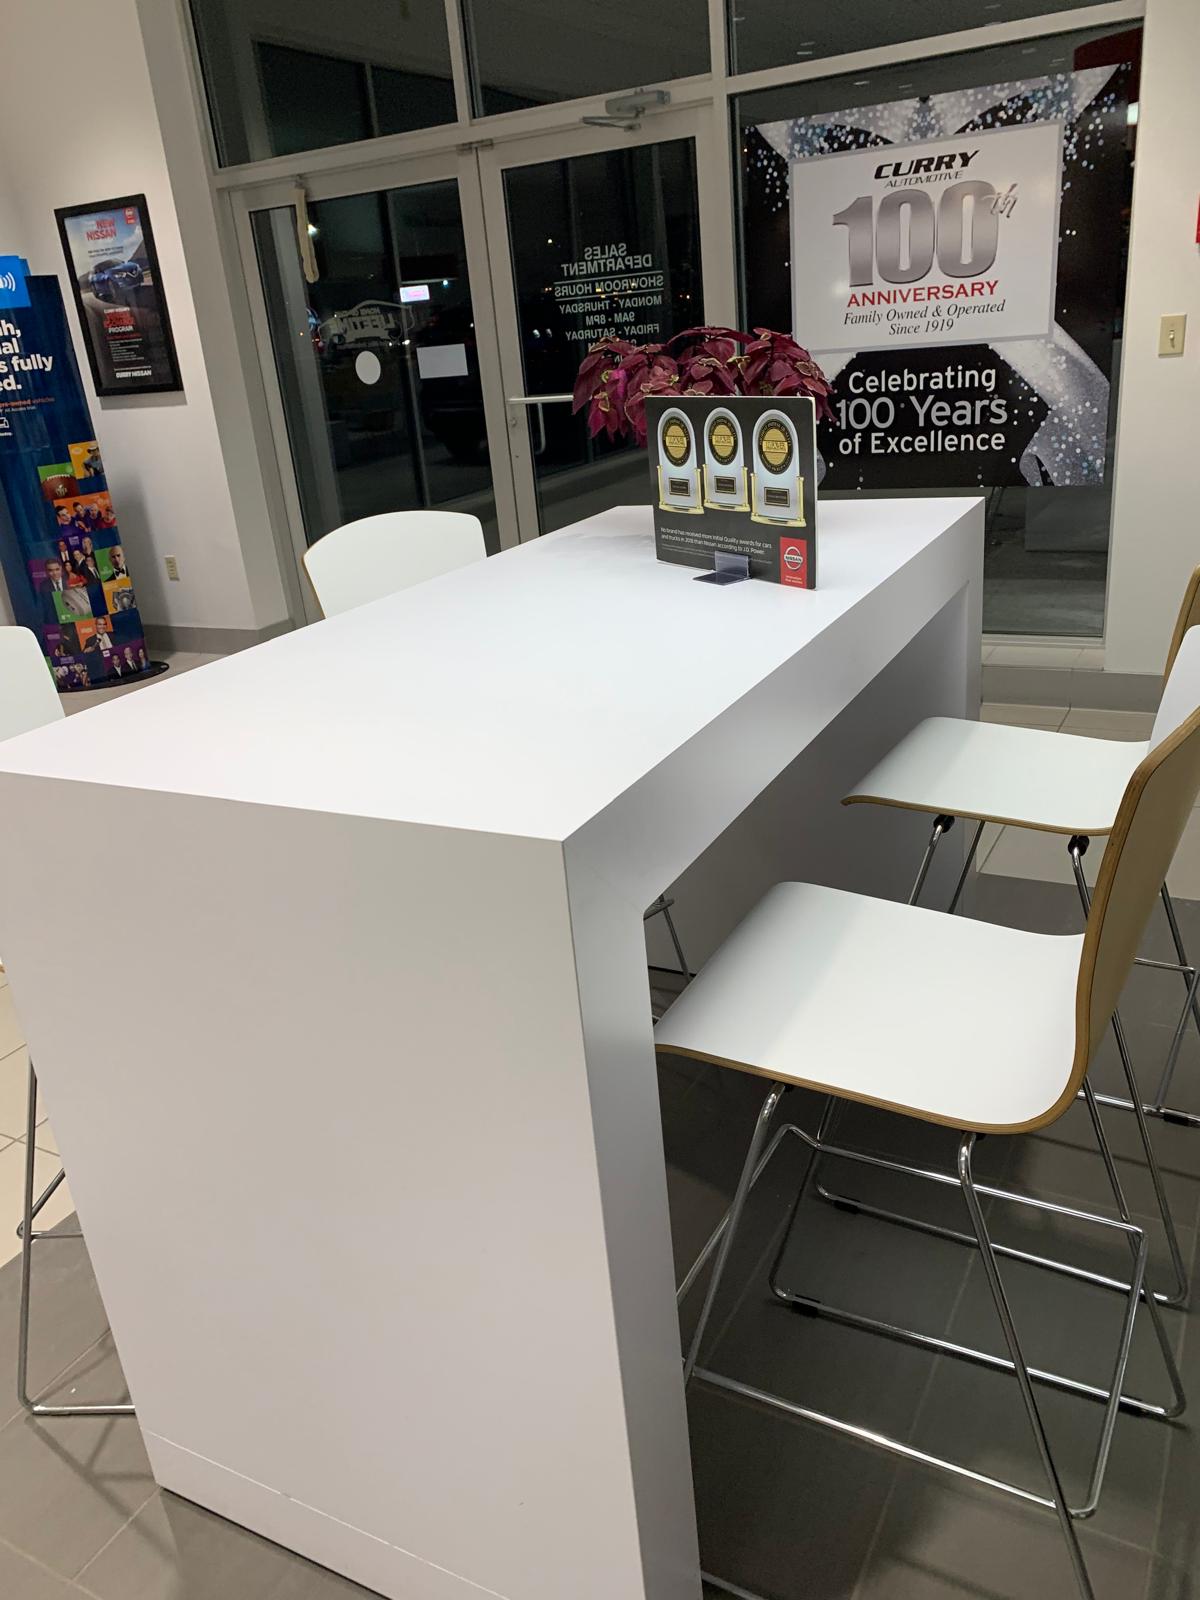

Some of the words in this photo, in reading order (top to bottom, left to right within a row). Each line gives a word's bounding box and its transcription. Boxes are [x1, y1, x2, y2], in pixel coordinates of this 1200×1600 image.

[874, 150, 980, 179] CURRY
[884, 170, 963, 188] AUTOMOTIVE
[86, 228, 117, 241] NISSAN
[847, 280, 999, 308] ANNIVERSARY
[844, 310, 883, 325] Family
[886, 306, 929, 321] Owned
[931, 306, 943, 317] &
[947, 299, 1006, 320] Operated
[889, 322, 921, 336] Since
[925, 319, 954, 333] 1919
[12, 354, 53, 371] fully
[849, 365, 996, 394] Celebrating
[836, 397, 895, 430] 100
[909, 395, 1008, 427] Years
[839, 433, 862, 455] of
[871, 430, 1006, 454] Excellence
[718, 543, 738, 551] according
